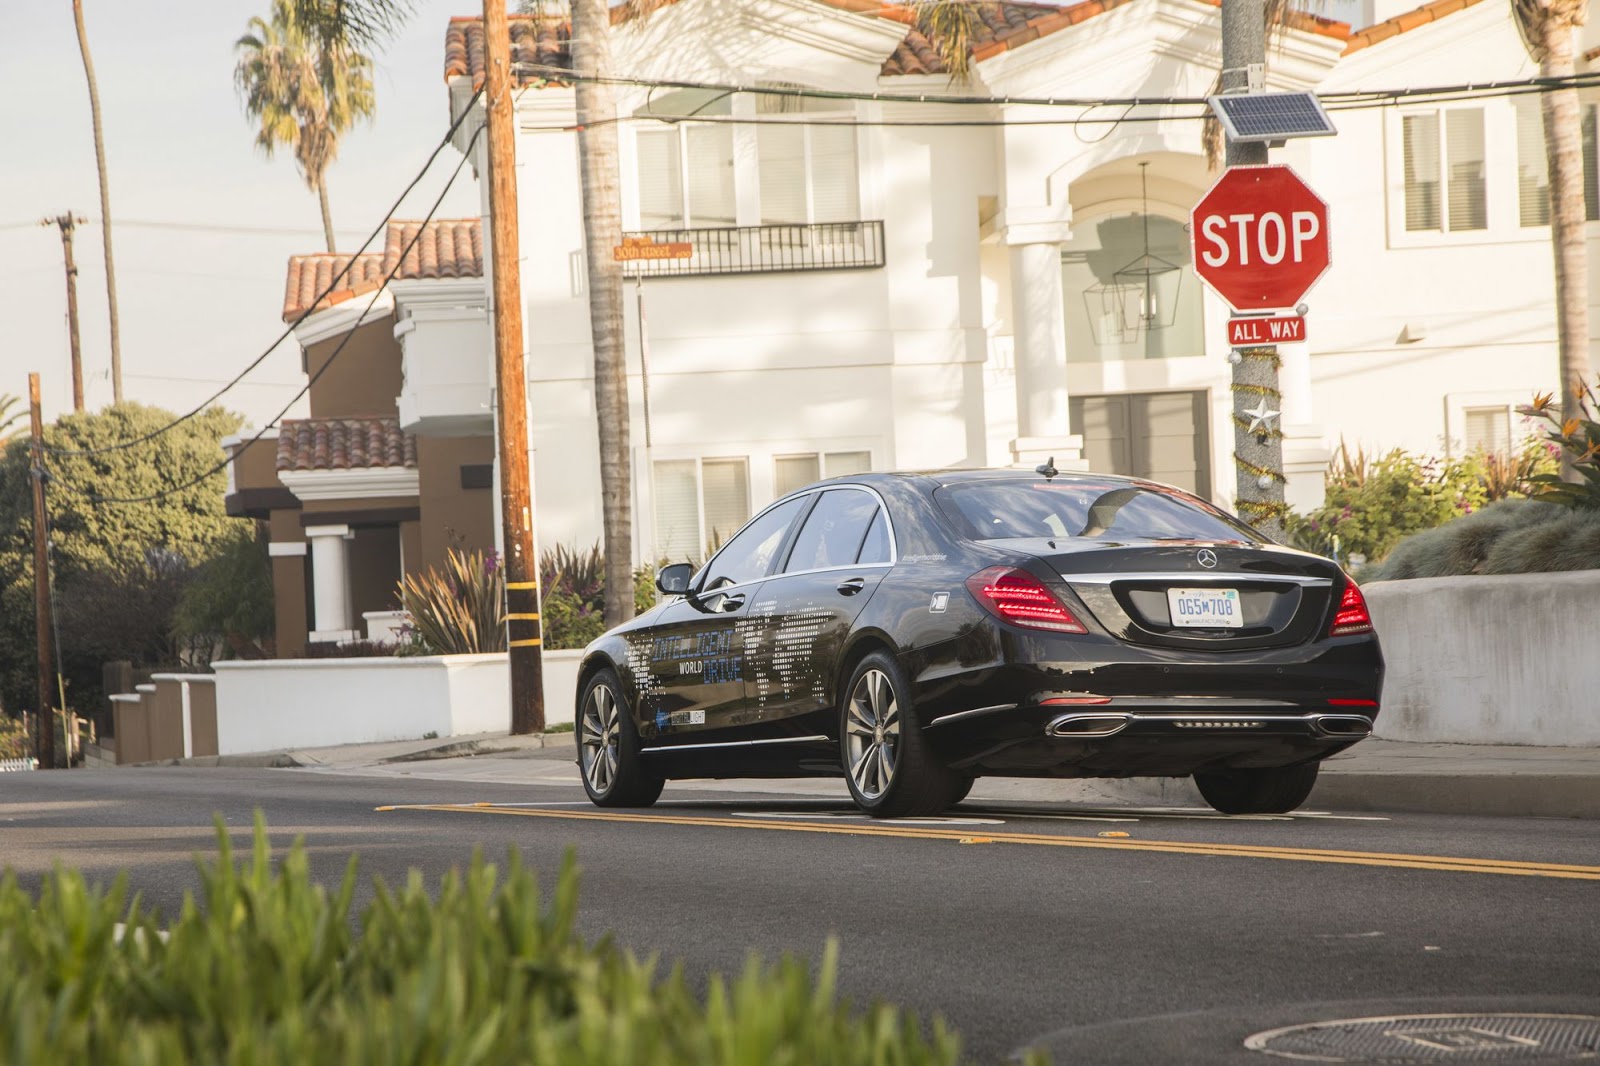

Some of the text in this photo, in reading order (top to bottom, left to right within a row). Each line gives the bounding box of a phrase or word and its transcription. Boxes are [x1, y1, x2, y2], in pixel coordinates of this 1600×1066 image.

[1202, 211, 1320, 268] STOP
[615, 246, 639, 260] 30th
[640, 245, 671, 259] street
[1234, 320, 1299, 341] ALL WAY
[1178, 598, 1233, 615] 065M708
[652, 629, 734, 661] INTELLIGENT
[679, 655, 743, 684] WORLD DRIVE
